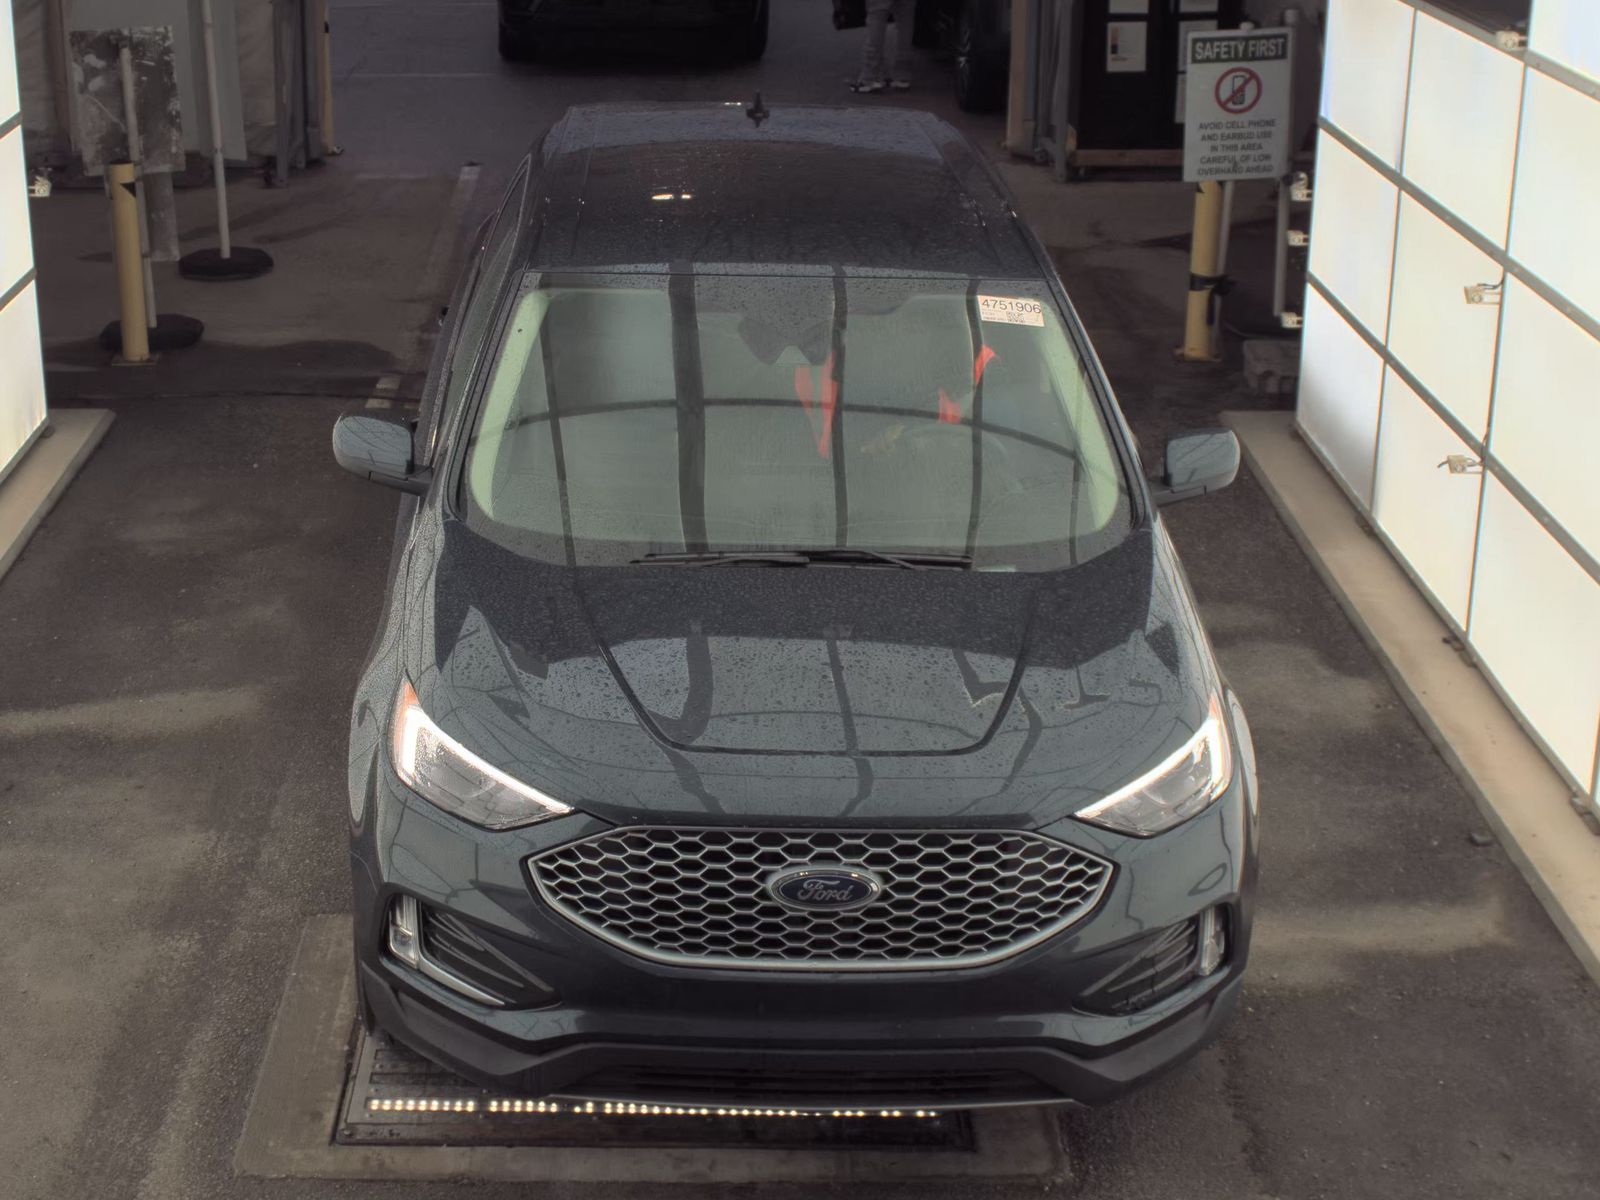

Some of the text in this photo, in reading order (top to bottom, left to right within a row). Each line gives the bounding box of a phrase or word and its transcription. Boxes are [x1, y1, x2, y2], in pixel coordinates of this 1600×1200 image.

[1195, 38, 1285, 60] SAFETY FIRST
[1199, 119, 1276, 130] AVOID CELL PHONE
[1201, 133, 1219, 142] AND
[1210, 142, 1263, 153] IN THIS AREA
[1200, 153, 1272, 165] CAREFUL OF LOW
[1245, 164, 1274, 174] AHEAD
[982, 299, 1042, 313] 4751906
[797, 879, 854, 901] Ford
